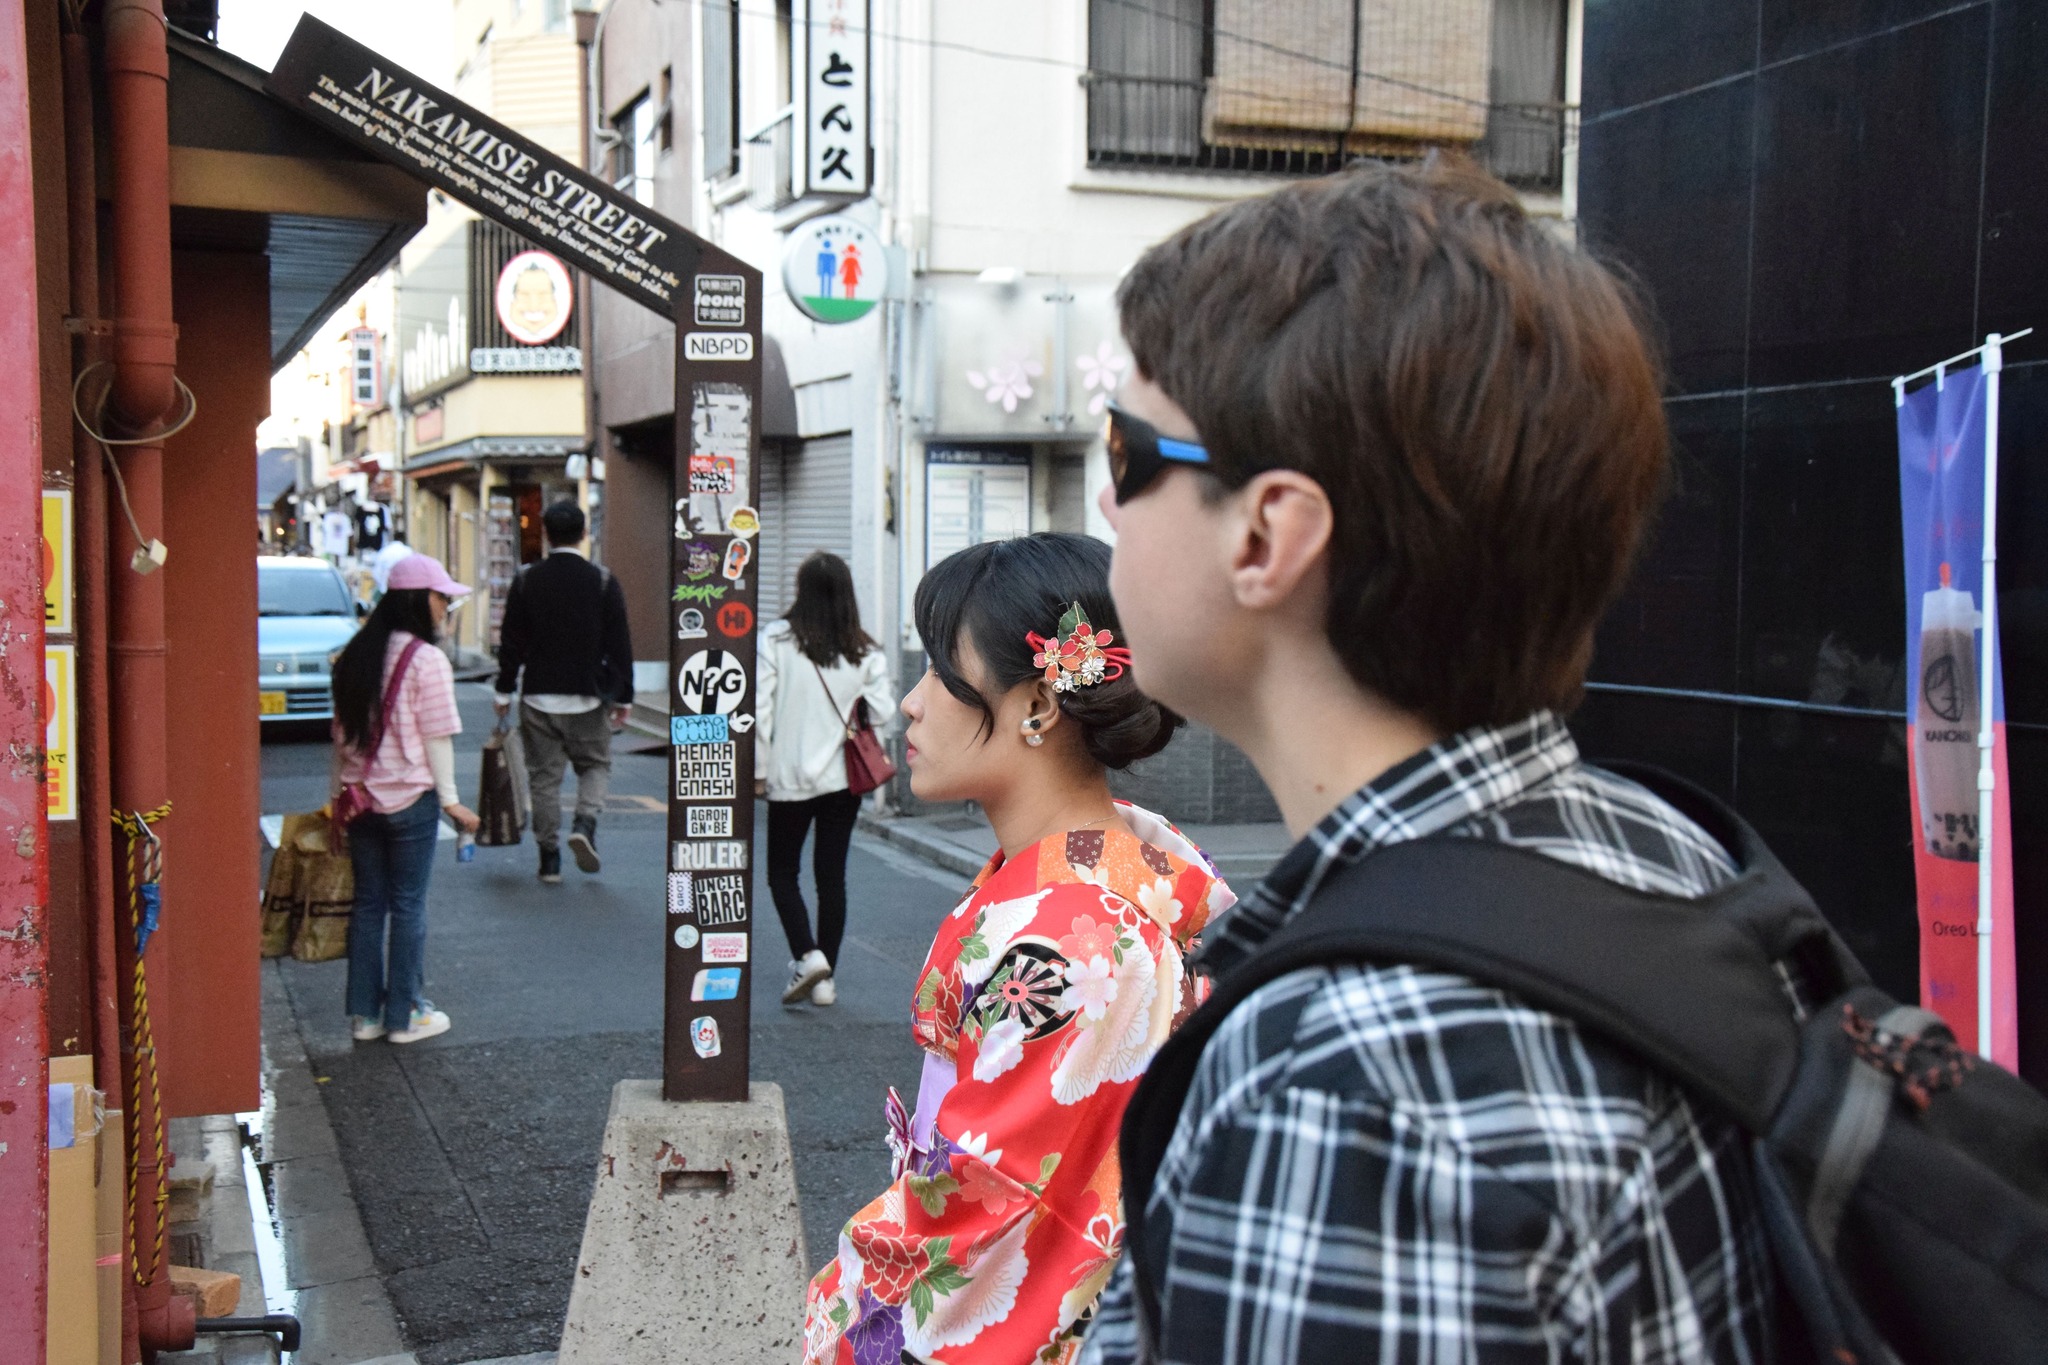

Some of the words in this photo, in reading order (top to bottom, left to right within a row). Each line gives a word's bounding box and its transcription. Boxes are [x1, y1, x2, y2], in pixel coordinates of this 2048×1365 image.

[821, 52, 854, 181] とん久
[356, 69, 538, 183] NAKAMISE
[532, 170, 667, 254] STREET
[317, 74, 341, 96] The
[339, 90, 371, 113] main
[401, 126, 435, 150] from
[433, 143, 454, 160] the
[452, 152, 531, 204] Kaminarimon
[529, 196, 561, 220] (God
[556, 211, 576, 228] of
[572, 219, 625, 256] Thunder)
[622, 248, 650, 271] Gate
[648, 264, 662, 278] to
[660, 271, 680, 288] the
[308, 91, 341, 114] main
[339, 106, 368, 127] hall
[363, 120, 382, 137] of
[375, 125, 397, 145] the
[437, 159, 479, 195] Temple,
[480, 188, 508, 208] with
[504, 203, 530, 220] gift
[527, 214, 561, 237] shops
[557, 229, 590, 254] lined
[584, 245, 618, 273] along
[615, 262, 643, 284] both
[640, 278, 670, 301] sides.
[691, 337, 749, 355] NBPD
[678, 743, 733, 761] HENKA
[680, 761, 732, 779] BAMS
[678, 779, 734, 797] GNASH
[690, 809, 729, 822] AGROH
[677, 842, 743, 869] RULER
[696, 875, 743, 894] UNCLE
[697, 889, 746, 925] BARC
[1932, 920, 1968, 937] Oreo
